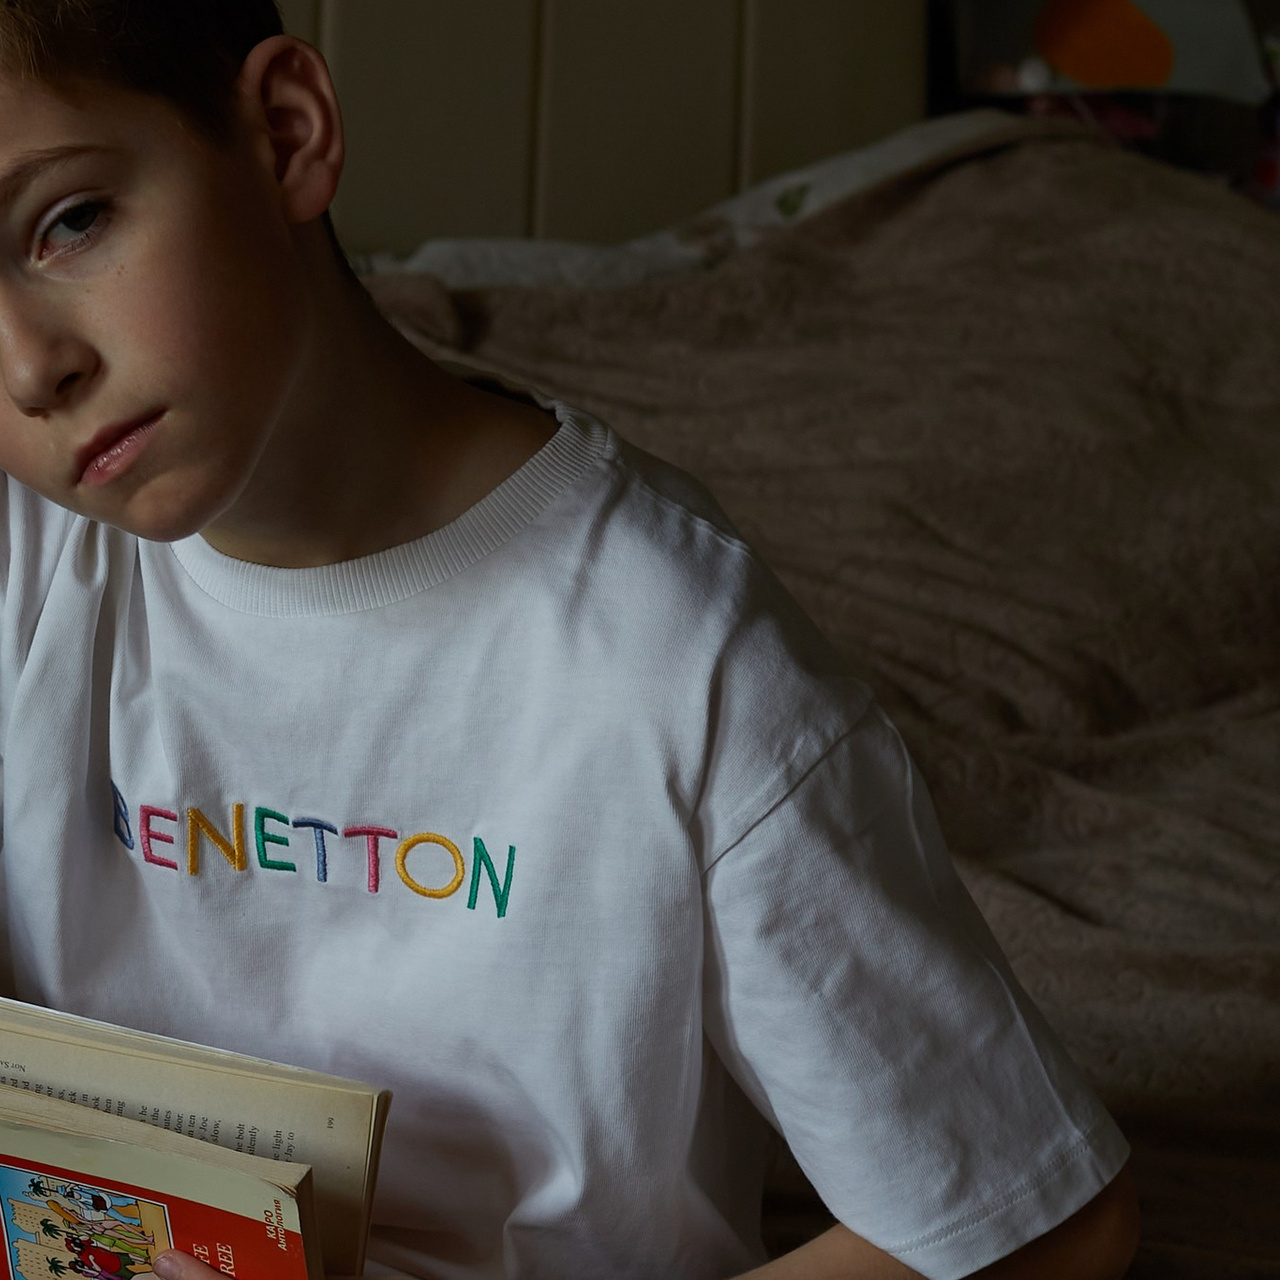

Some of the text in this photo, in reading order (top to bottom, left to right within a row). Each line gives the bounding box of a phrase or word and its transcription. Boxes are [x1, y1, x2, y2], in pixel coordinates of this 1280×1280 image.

[150, 1107, 160, 1121] the
[211, 1119, 221, 1143] slow,
[236, 1123, 245, 1140] bolt
[272, 1130, 284, 1150] light
[264, 1209, 277, 1239] КАРО
[216, 1242, 236, 1277] REE
